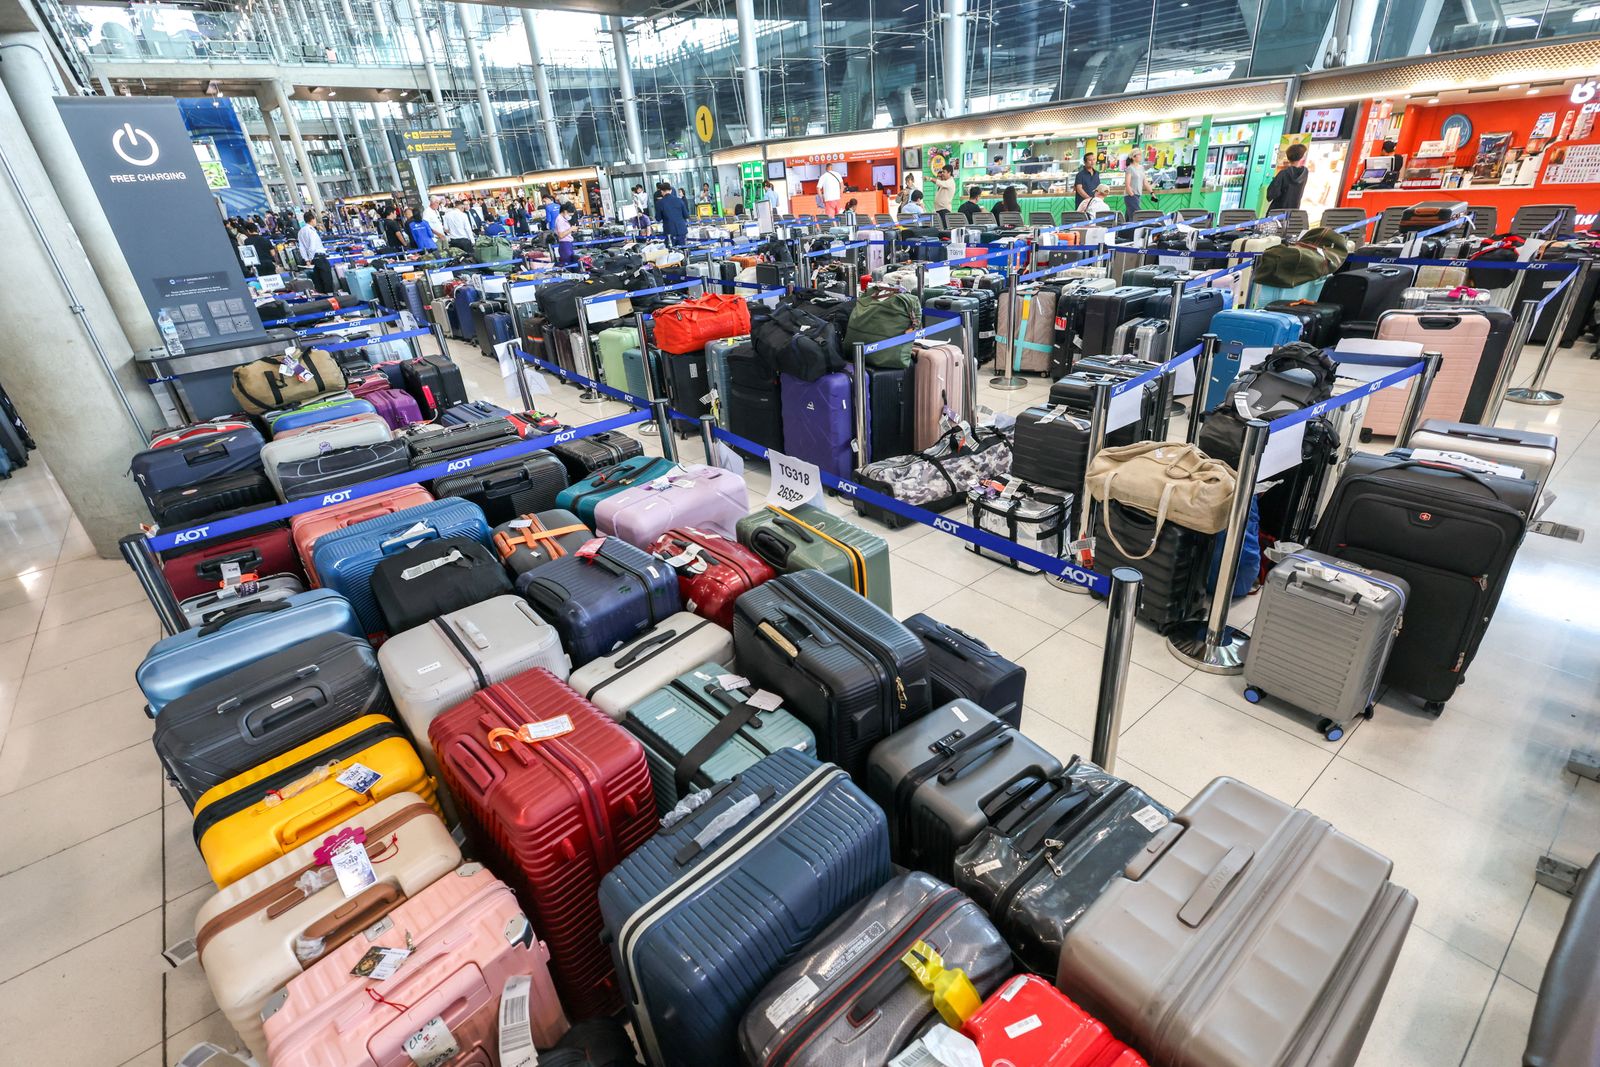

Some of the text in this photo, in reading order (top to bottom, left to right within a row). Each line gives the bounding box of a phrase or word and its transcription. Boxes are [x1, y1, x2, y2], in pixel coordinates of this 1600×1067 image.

[701, 113, 707, 135] 1
[110, 171, 187, 183] FREE CHARGING
[867, 344, 878, 352] AOT
[1369, 380, 1382, 392] AOT
[1311, 403, 1327, 416] AOT
[554, 430, 576, 443] AOT
[447, 458, 472, 472] AOT
[779, 463, 810, 486] TG318
[838, 480, 858, 495] AOT
[322, 489, 352, 506] AOT
[933, 518, 959, 534] AOT
[174, 526, 209, 544] AOT
[1061, 566, 1098, 587] AOT
